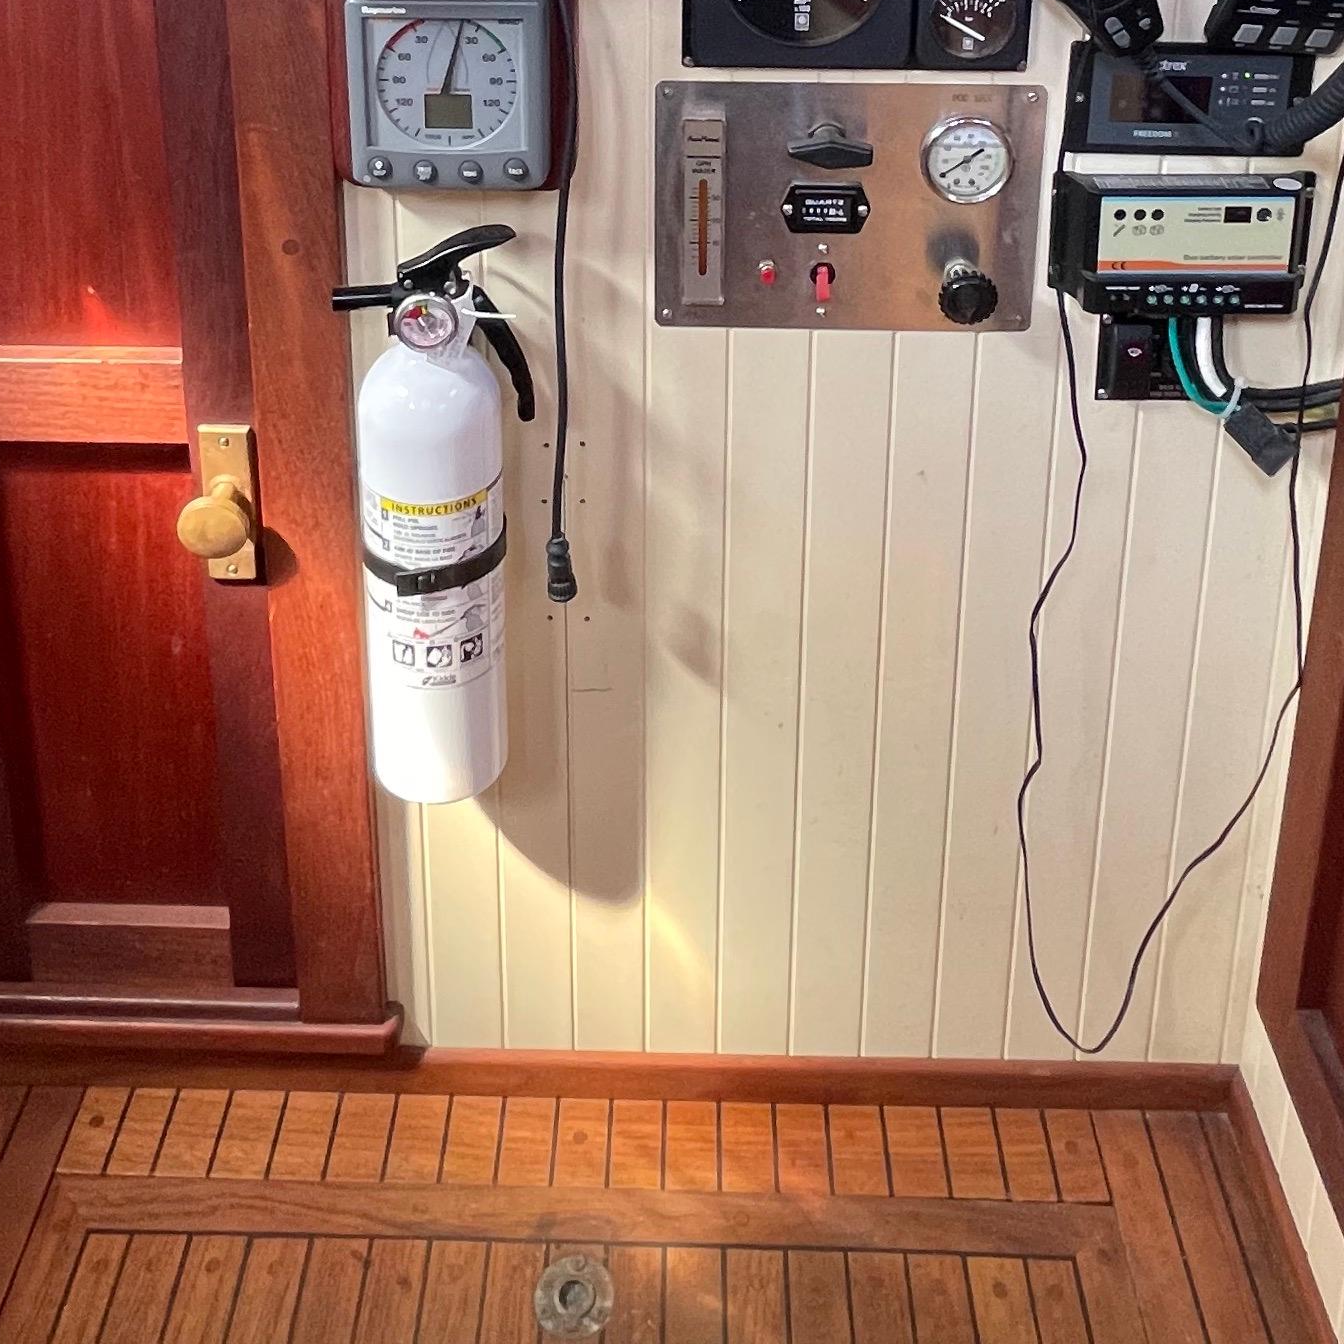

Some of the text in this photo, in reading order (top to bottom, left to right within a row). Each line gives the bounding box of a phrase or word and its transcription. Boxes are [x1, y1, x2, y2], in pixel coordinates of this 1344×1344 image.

[415, 36, 478, 44] 30 30
[398, 52, 496, 62] 60 60
[489, 77, 503, 85] 90
[395, 98, 501, 107] 120 120
[391, 498, 476, 515] INSTRUCTIONS
